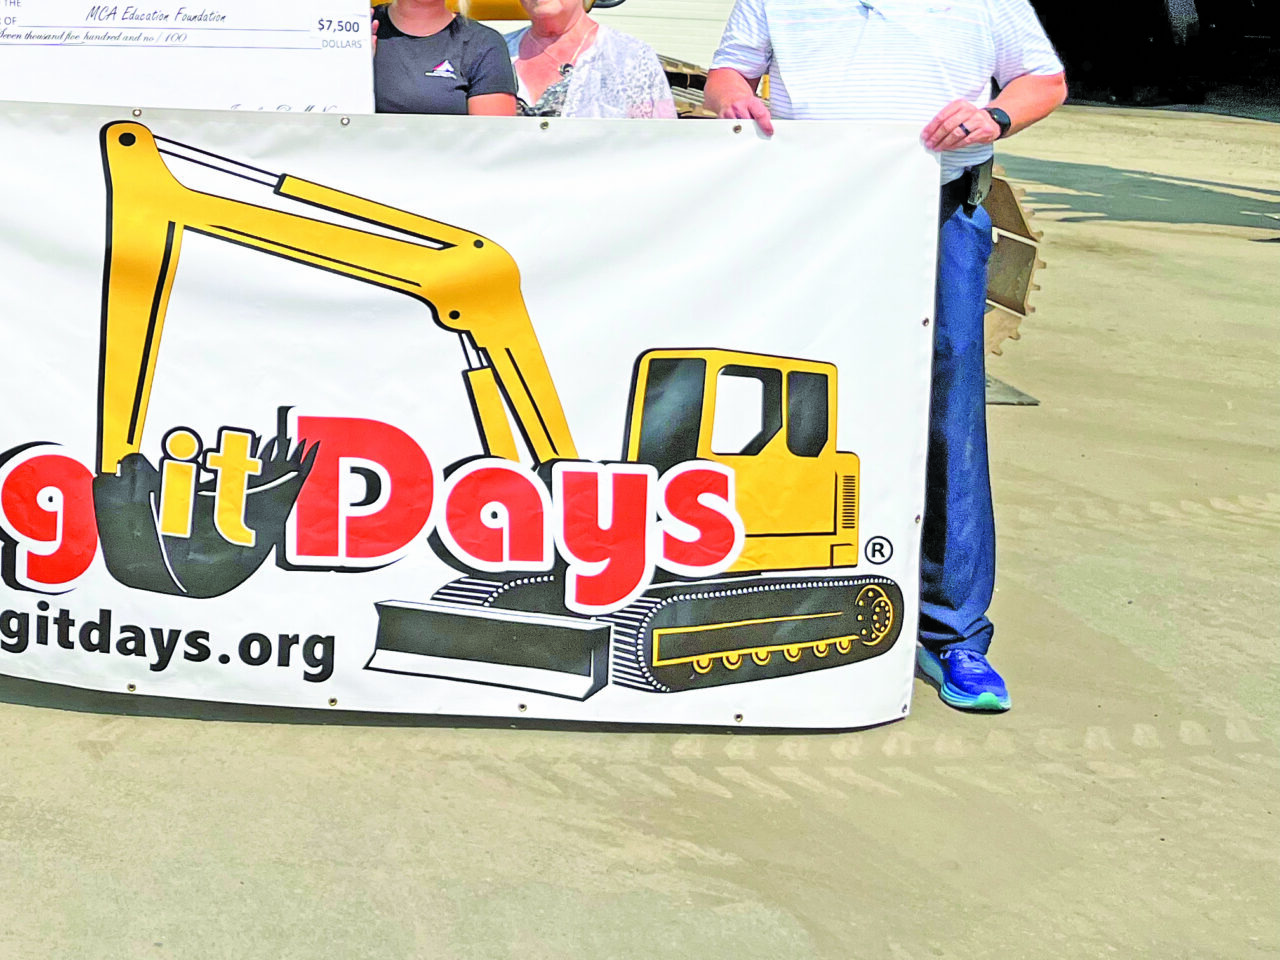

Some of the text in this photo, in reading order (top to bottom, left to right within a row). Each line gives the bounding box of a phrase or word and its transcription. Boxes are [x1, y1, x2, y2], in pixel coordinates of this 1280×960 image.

[4, 16, 17, 25] OF
[85, 5, 227, 23] MCA Education Foundation
[317, 18, 360, 34] $7,500
[24, 30, 65, 41] thousand
[83, 31, 122, 41] hundred
[122, 32, 143, 42] and
[321, 39, 362, 49] DOLLARS
[158, 426, 263, 546] it
[286, 410, 744, 610] Days
